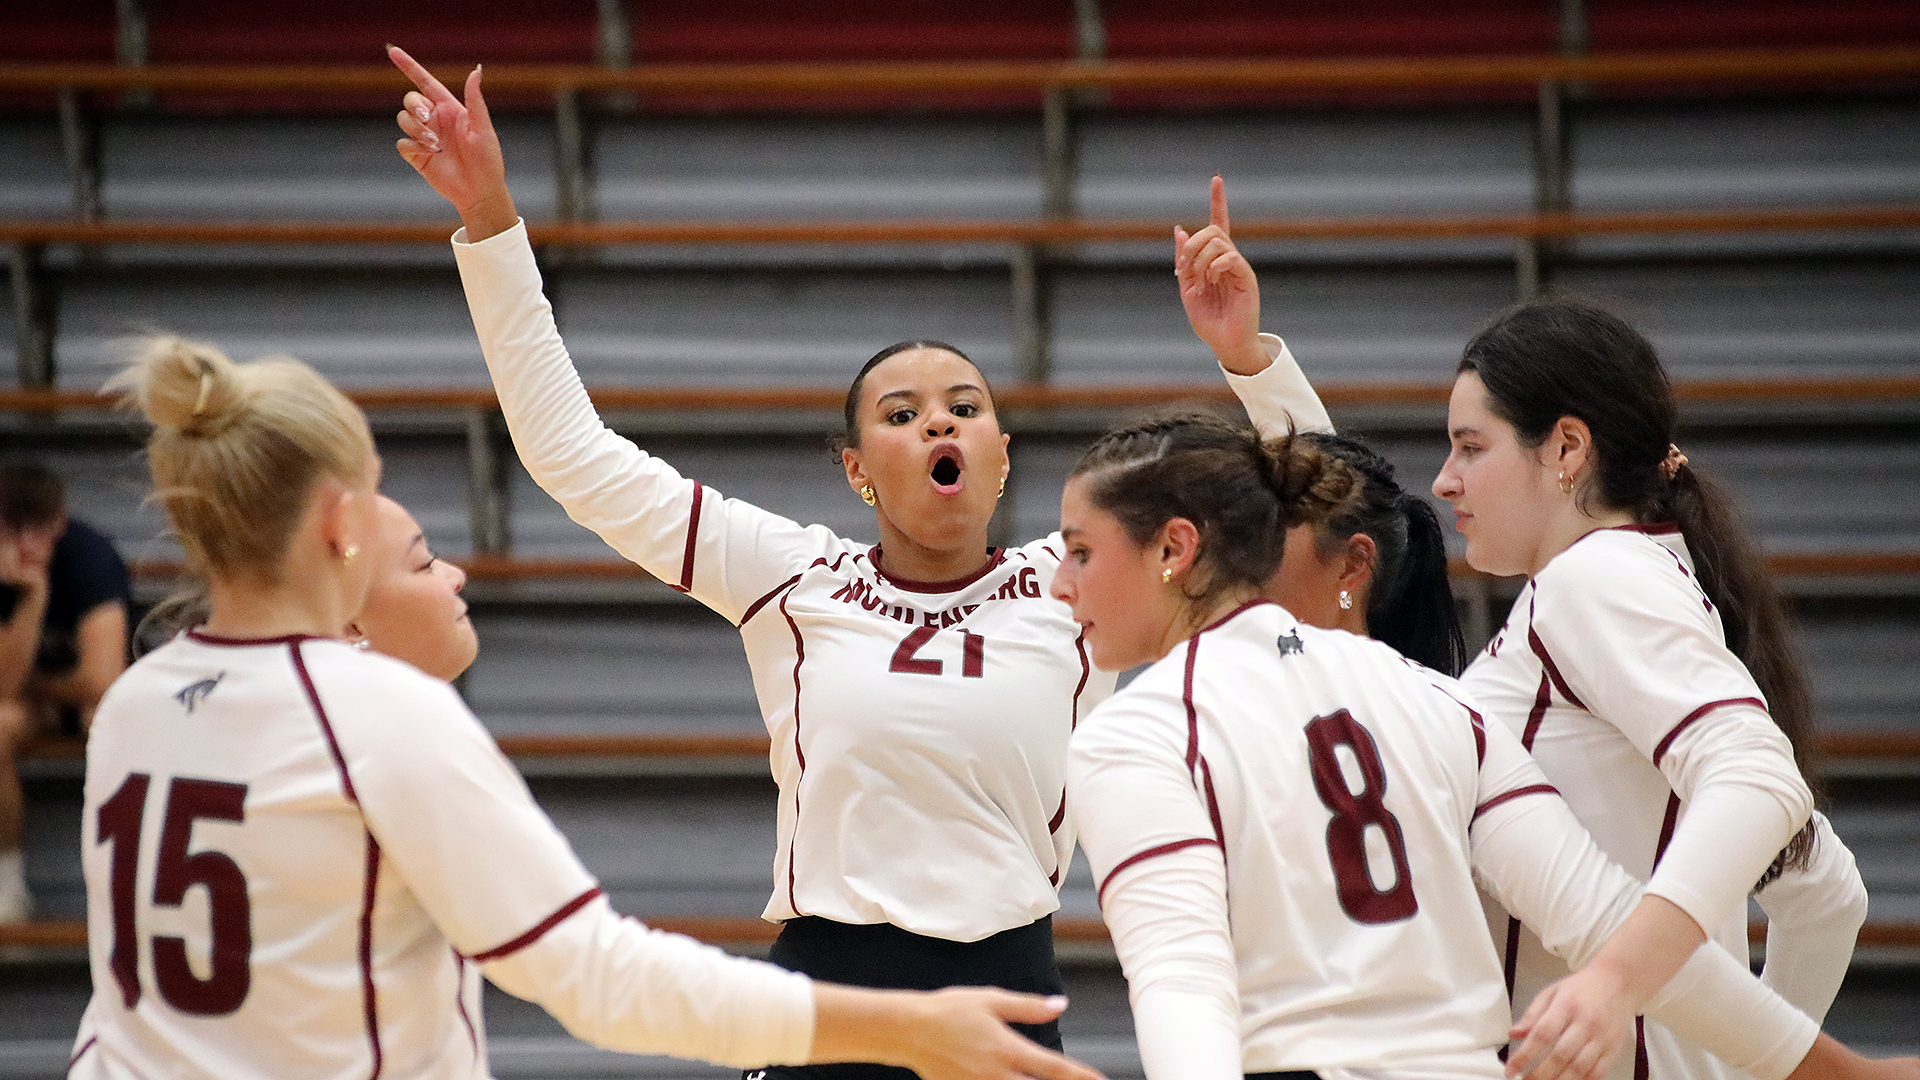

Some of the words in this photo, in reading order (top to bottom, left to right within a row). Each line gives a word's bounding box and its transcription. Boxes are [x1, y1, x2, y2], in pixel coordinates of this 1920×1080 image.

[830, 567, 1042, 629] MUENRG
[888, 626, 984, 679] 21
[1303, 708, 1419, 927] 8
[96, 772, 252, 1018] 15
